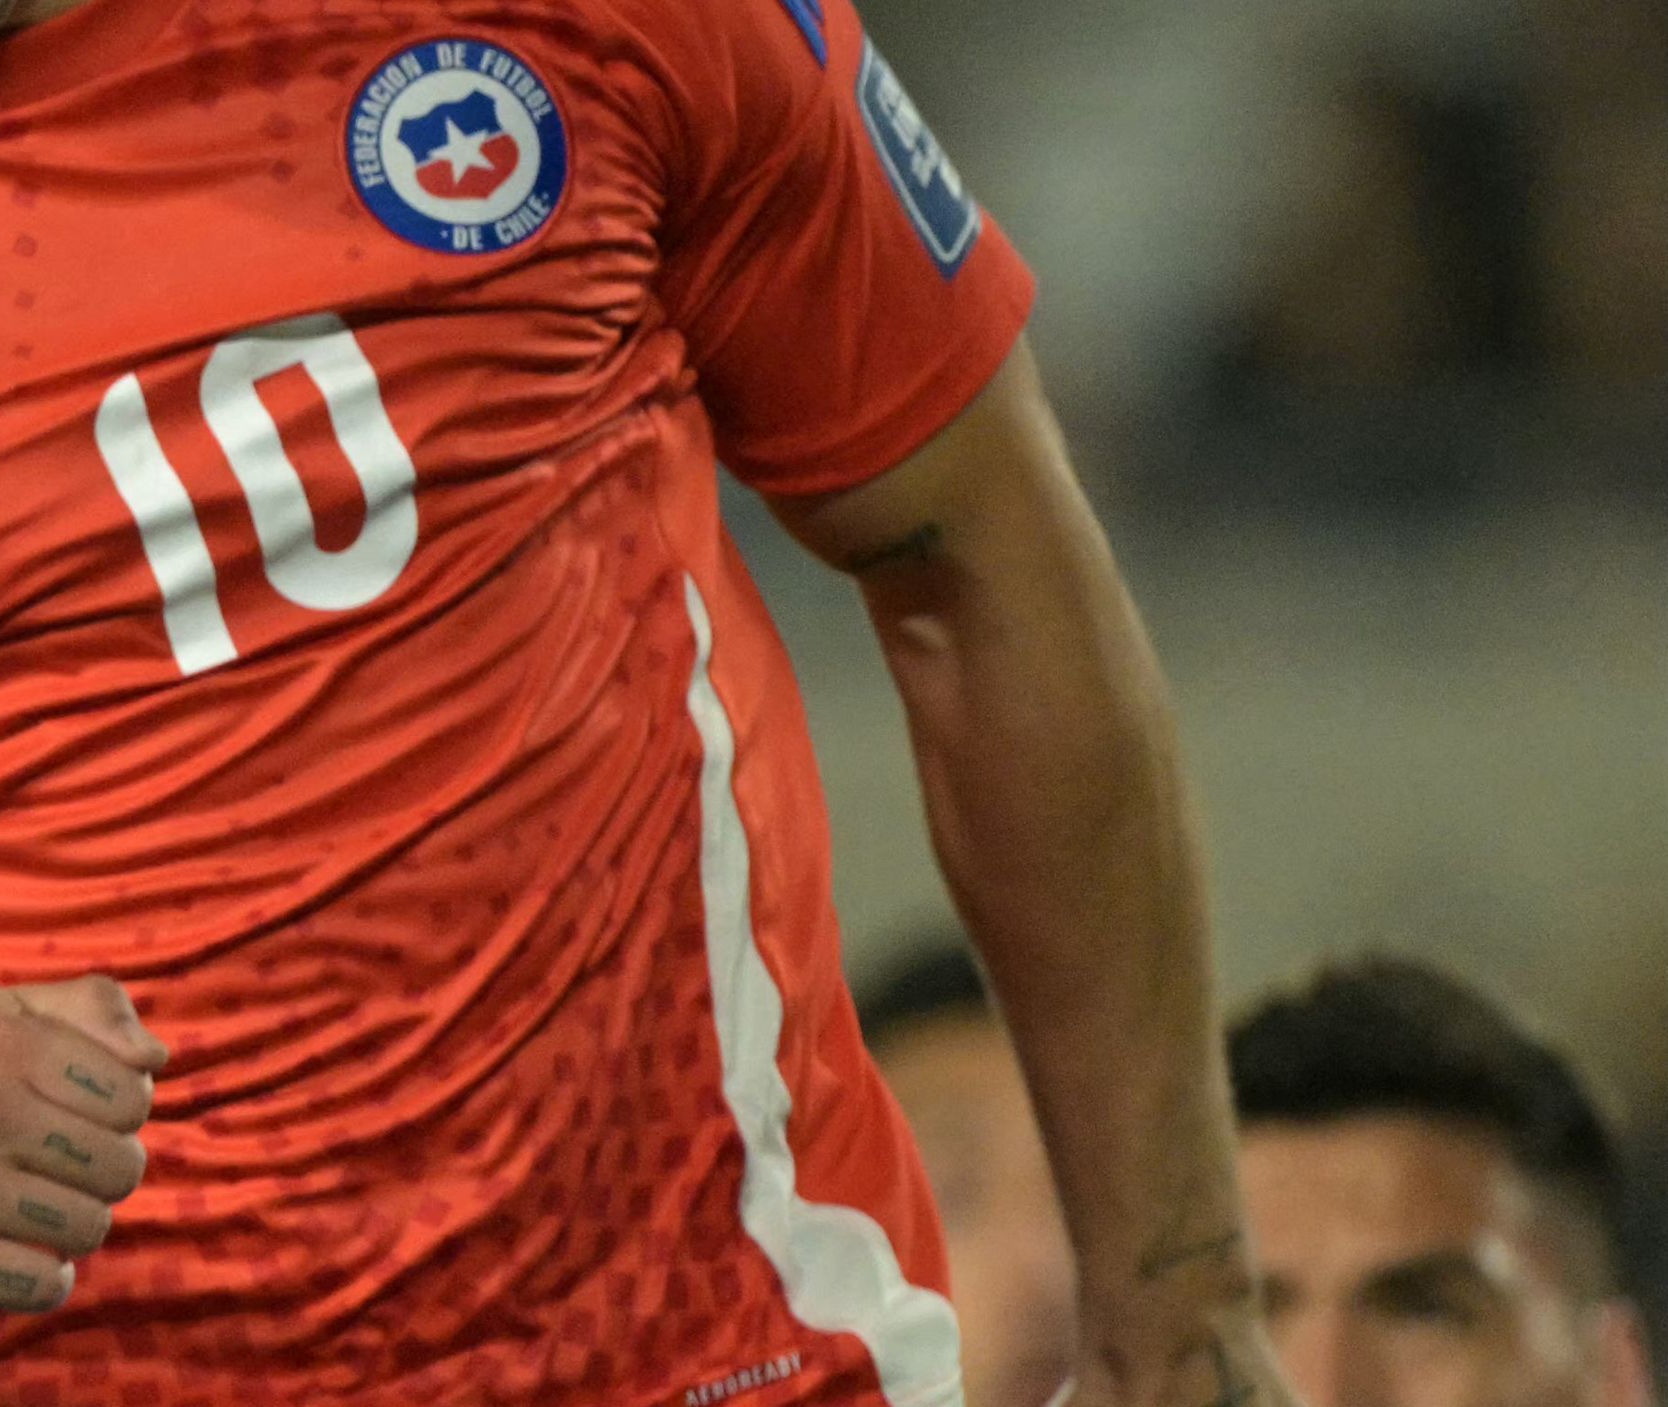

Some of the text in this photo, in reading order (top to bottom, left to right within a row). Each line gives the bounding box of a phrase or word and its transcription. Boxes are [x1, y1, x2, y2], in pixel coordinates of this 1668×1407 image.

[353, 42, 553, 188] FEDERACION DE FUTBOL
[452, 196, 552, 251] DE CHILE
[94, 311, 419, 677] 10
